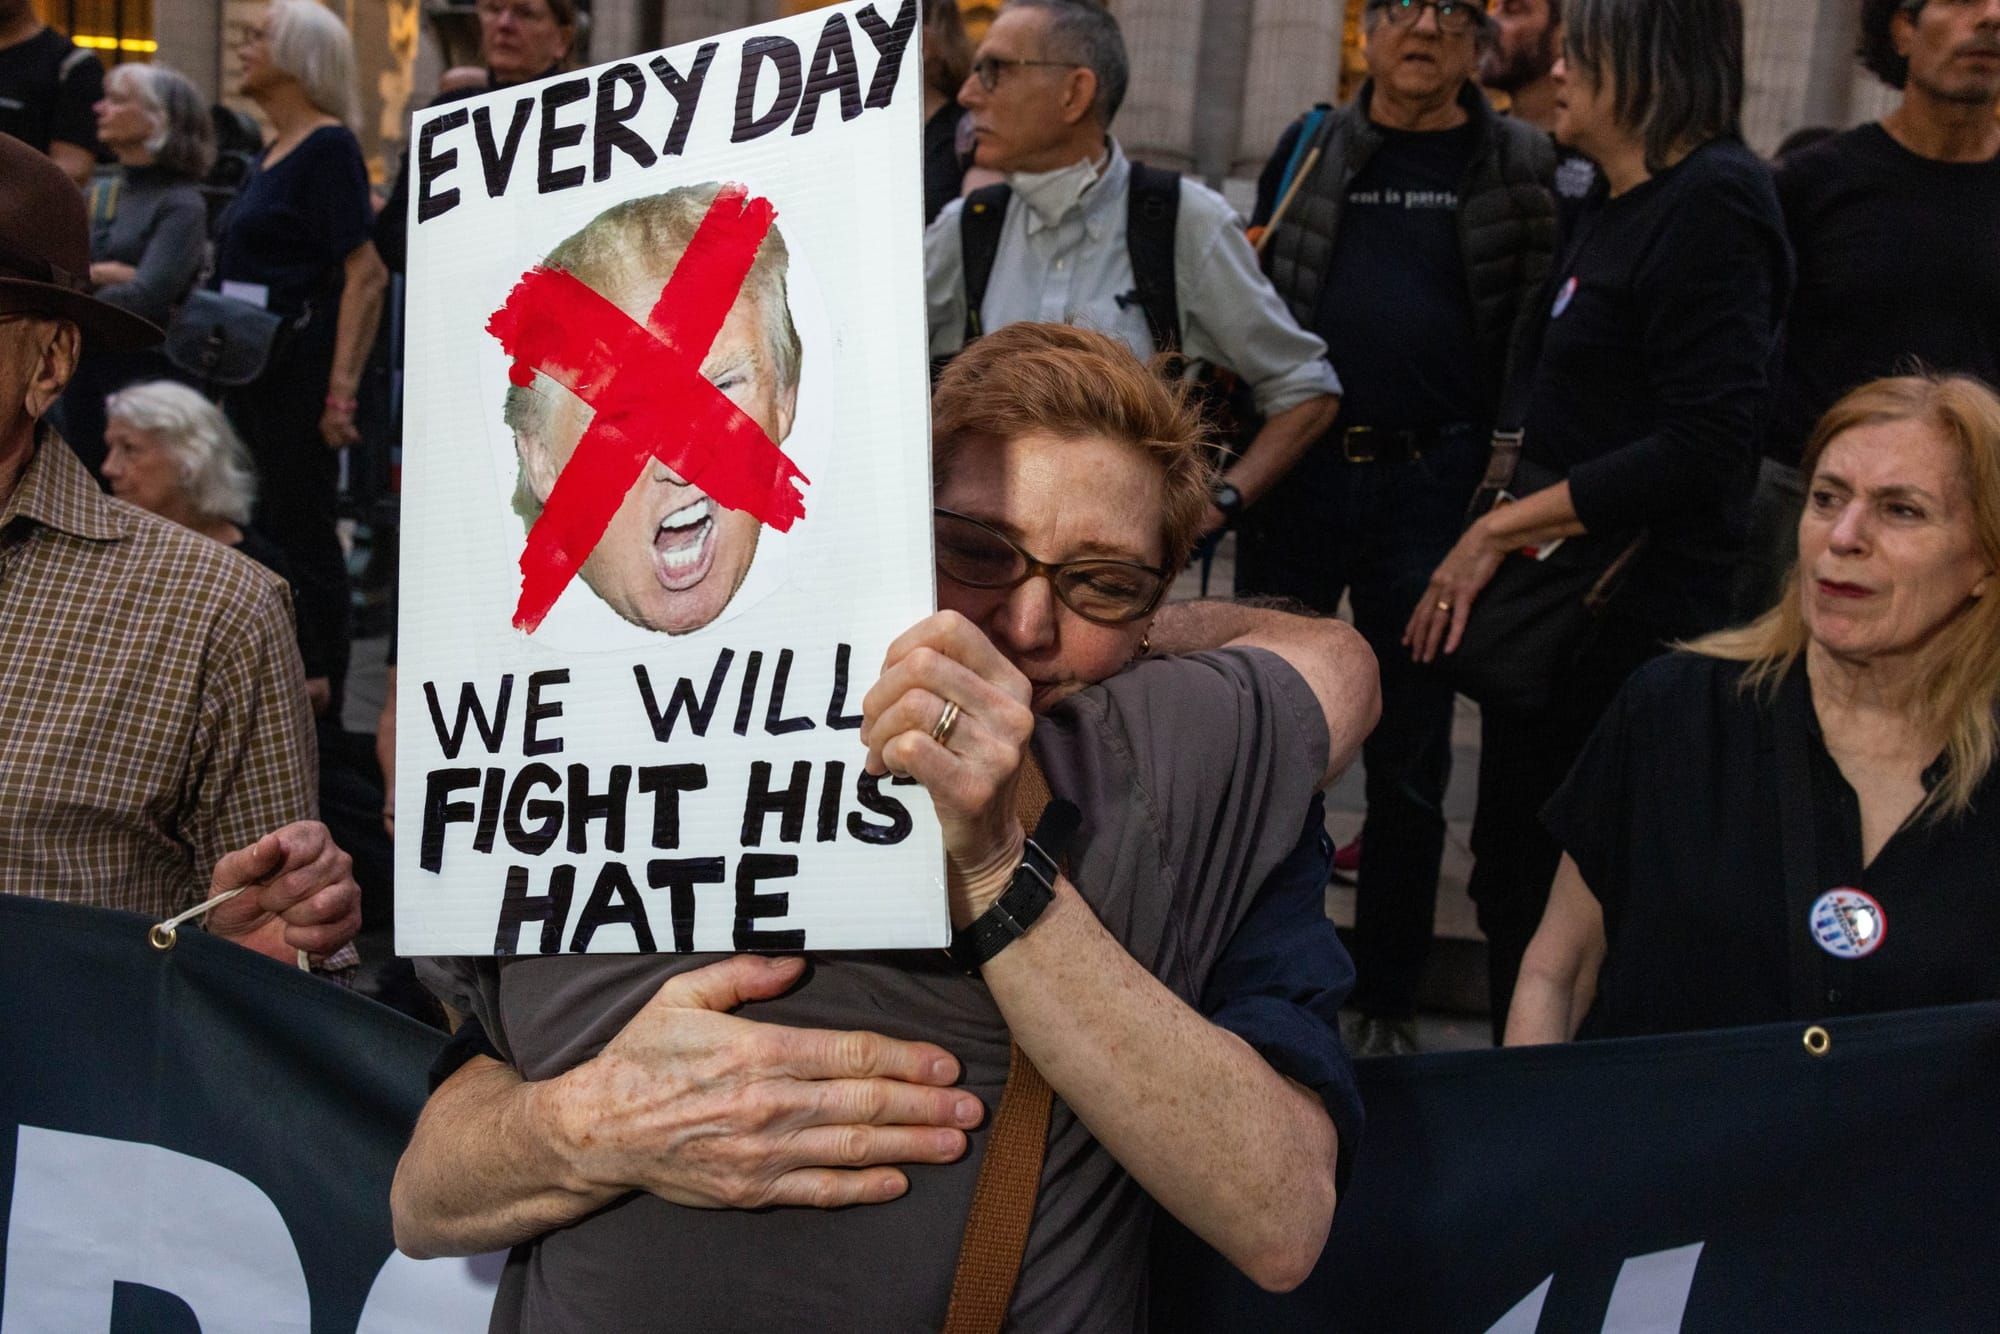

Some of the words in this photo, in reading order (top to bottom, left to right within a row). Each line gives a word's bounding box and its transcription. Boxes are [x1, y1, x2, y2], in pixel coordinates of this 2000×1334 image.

[418, 43, 719, 224] EVERY
[730, 0, 917, 143] DAY
[423, 668, 570, 759] WE
[633, 643, 864, 743] WILL
[420, 761, 708, 874] FIGHT
[740, 760, 916, 847] HIS
[494, 854, 806, 954] HATE
